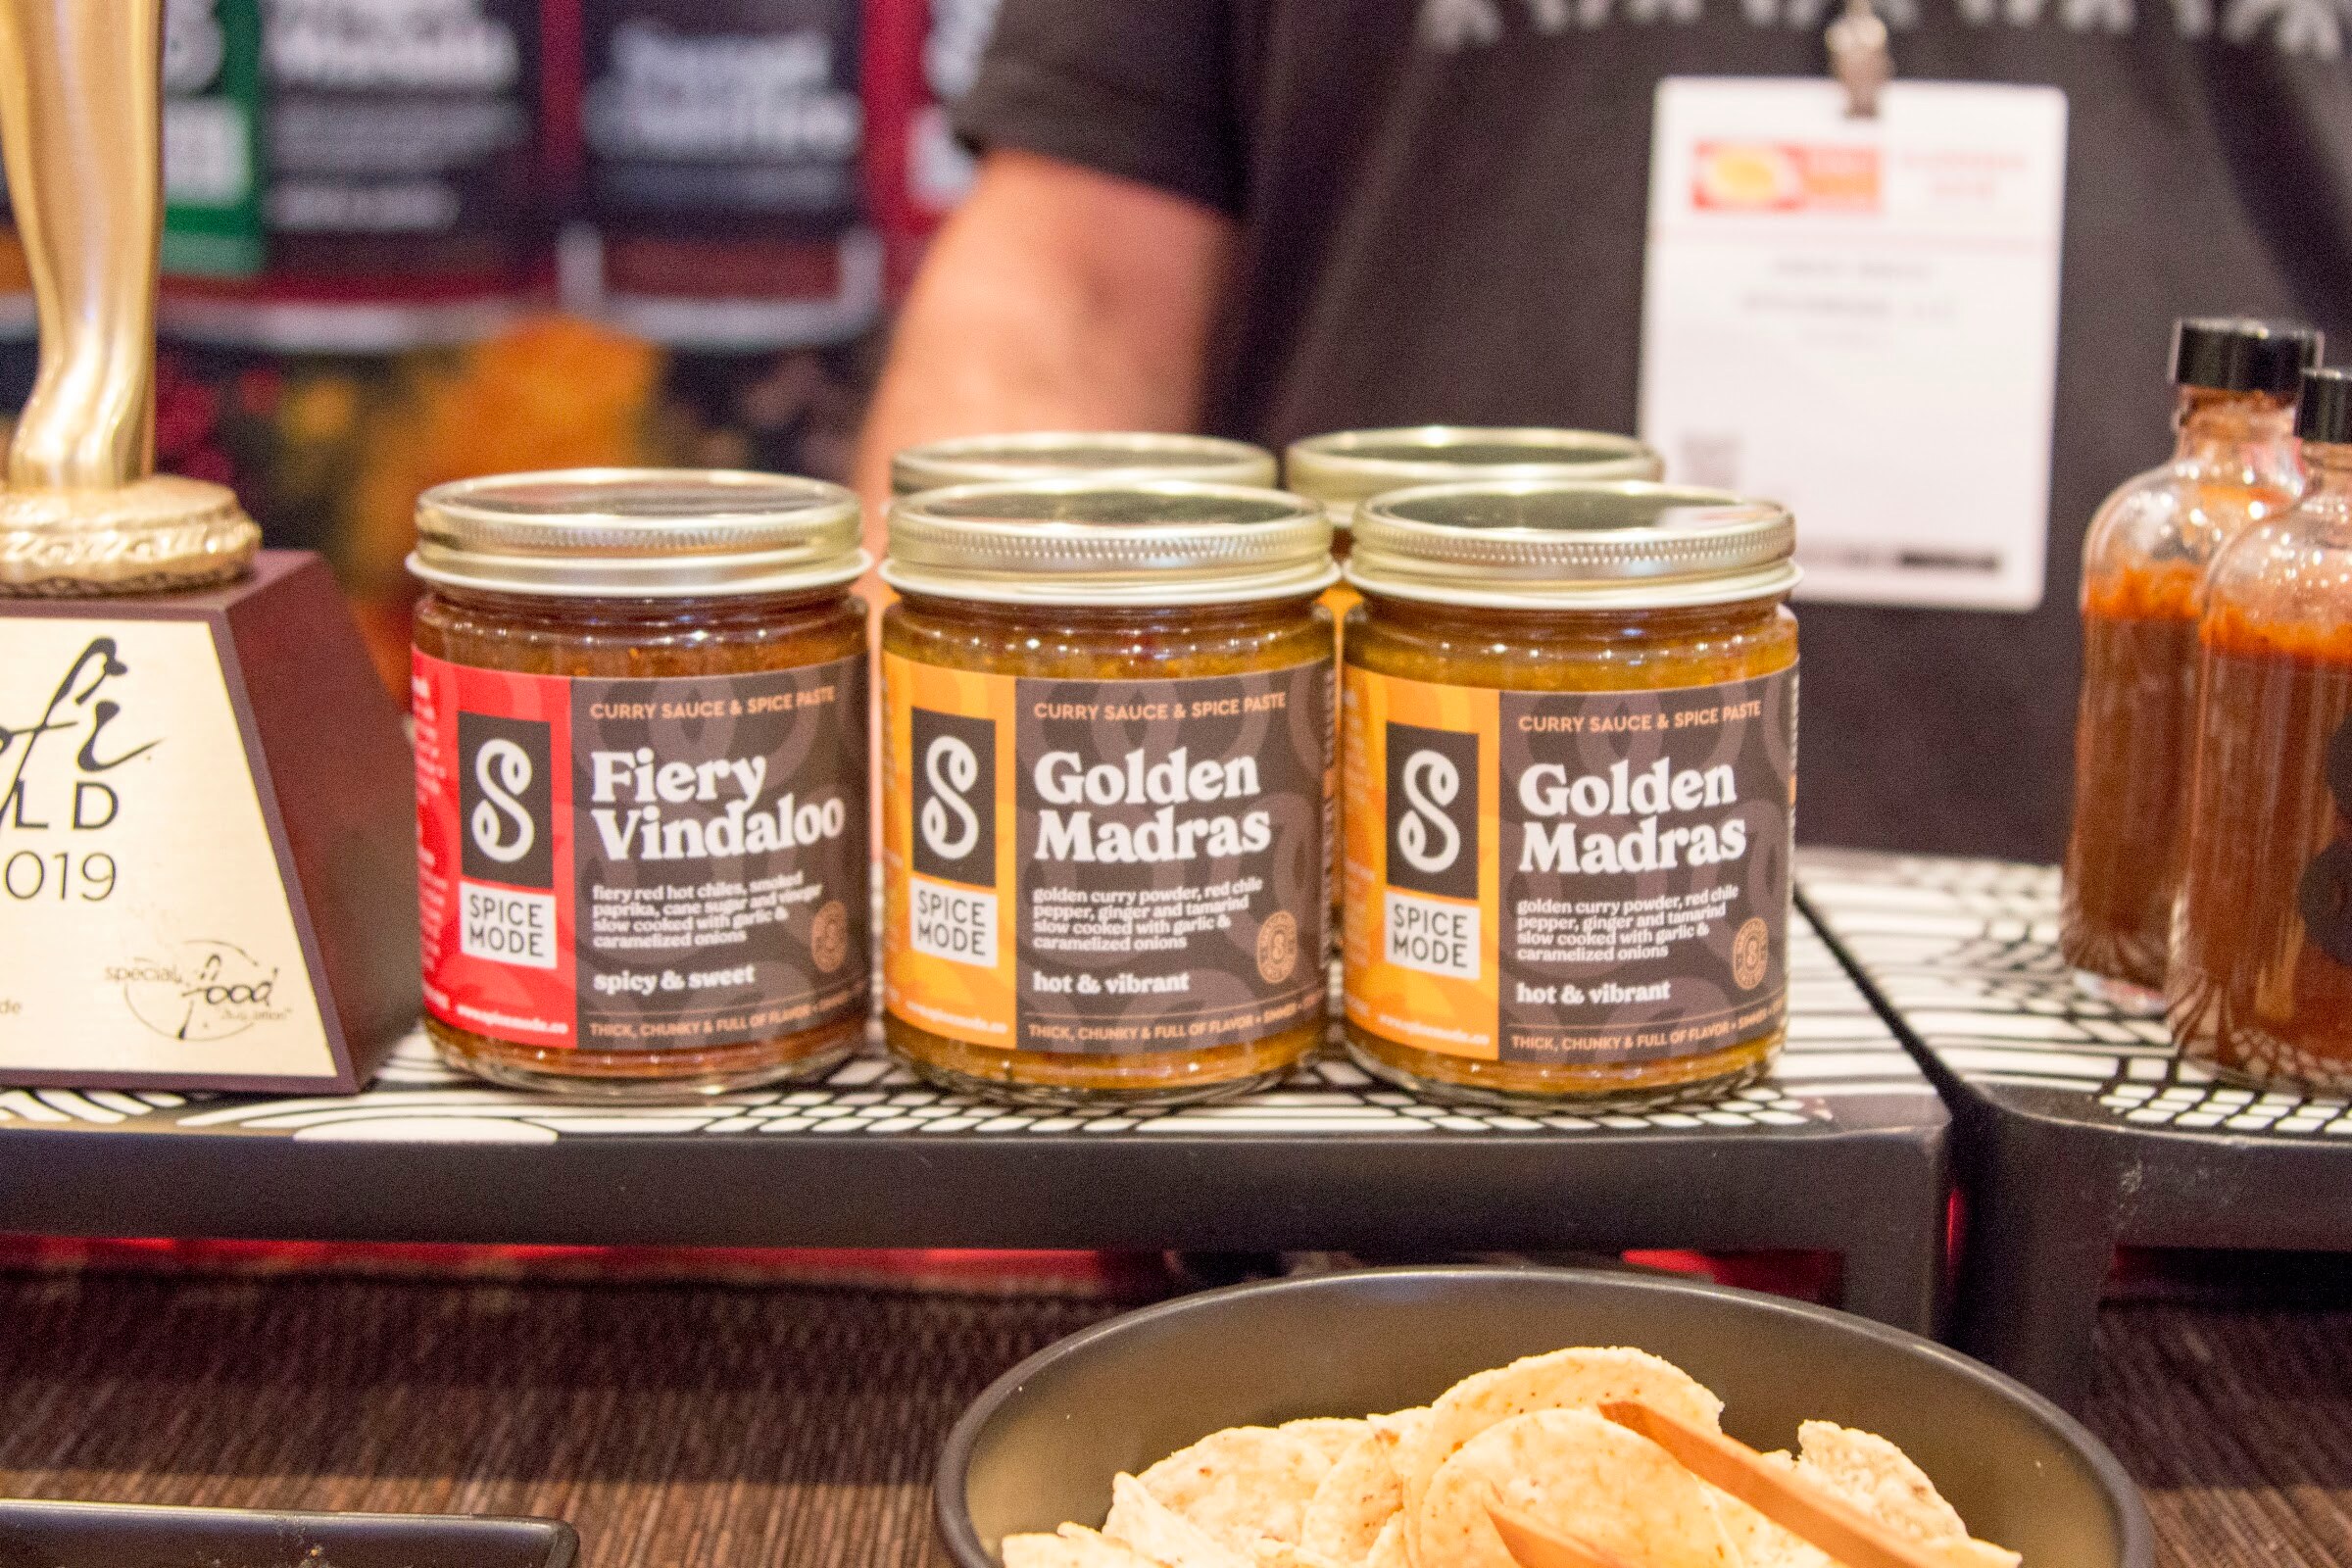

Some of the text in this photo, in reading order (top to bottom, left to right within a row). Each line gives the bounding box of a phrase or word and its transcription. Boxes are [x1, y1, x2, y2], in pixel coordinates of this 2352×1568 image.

[589, 685, 835, 720] CURRY SAUCE & SPICE PASTE
[1034, 692, 1287, 721] CURRY SAUCE & SPICE PASTE
[1518, 699, 1762, 733] CURRY SAUCE & SPICE PASTE
[591, 747, 766, 811] Fiery
[1034, 746, 1261, 806] Golden
[1518, 756, 1738, 817] Golden
[591, 792, 846, 861] Vindaloo
[1034, 805, 1272, 863] Madras
[1518, 815, 1747, 874] Madras
[634, 884, 664, 901] red
[666, 884, 695, 901] hot
[917, 890, 986, 928] SPICE
[1033, 888, 1088, 905] golden
[1090, 891, 1137, 906] curry
[1138, 886, 1202, 906] powder,
[1203, 881, 1231, 899] red
[1516, 898, 1573, 915] golden
[1575, 901, 1621, 917] curry
[1623, 894, 1684, 916] powder,
[1685, 888, 1709, 907] red
[469, 893, 544, 929] SPICE
[592, 917, 631, 933] slow
[632, 915, 695, 933] cooked
[696, 913, 731, 930] with
[1033, 906, 1096, 921] pepper,
[1098, 905, 1152, 923] ginger
[1153, 902, 1183, 918] and
[1033, 919, 1070, 934] slow
[1072, 920, 1133, 936] cooked
[1135, 919, 1171, 935] with
[1173, 916, 1215, 937] garlic
[1393, 903, 1469, 940] SPICE
[1516, 902, 1727, 935] pepper, ginger and tamarind
[468, 921, 544, 957] MODE
[694, 930, 748, 947] onions
[916, 922, 986, 956] MODE
[1033, 935, 1189, 953] caramelized onions
[1392, 932, 1469, 968] MODE
[1516, 929, 1555, 946] slow
[1556, 928, 1617, 947] cooked
[1619, 928, 1654, 945] with
[1655, 924, 1695, 945] garlic
[1516, 944, 1670, 962] caramelized onions
[593, 963, 756, 996] spicy & sweet
[1033, 970, 1190, 994] hot & vibrant
[1516, 981, 1671, 1005] hot & vibrant
[1636, 1032, 1666, 1048] FULL
